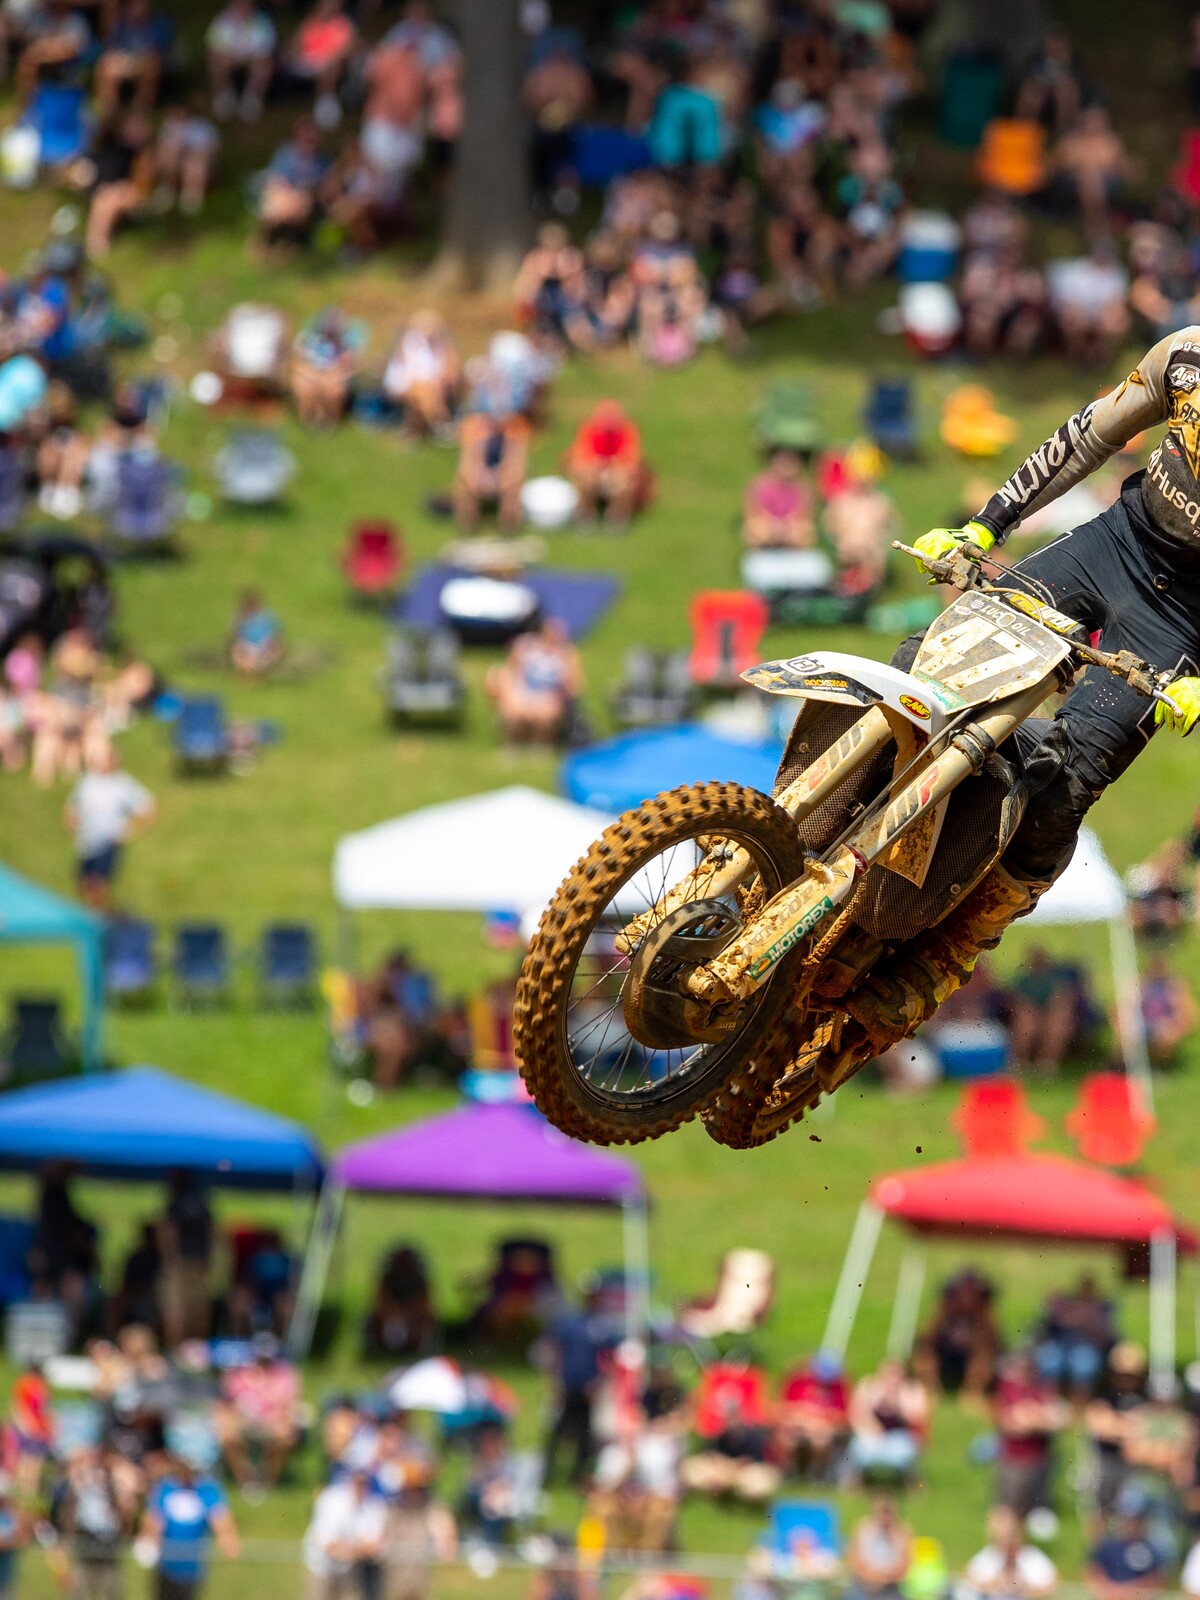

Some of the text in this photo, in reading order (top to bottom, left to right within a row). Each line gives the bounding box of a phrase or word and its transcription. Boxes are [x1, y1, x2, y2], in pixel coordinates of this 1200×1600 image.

[1011, 619, 1031, 636] OIL
[918, 616, 1039, 691] 47
[804, 679, 848, 688] ROCKSTAR
[900, 696, 931, 717] FMF
[769, 899, 831, 962] MOTOREX
